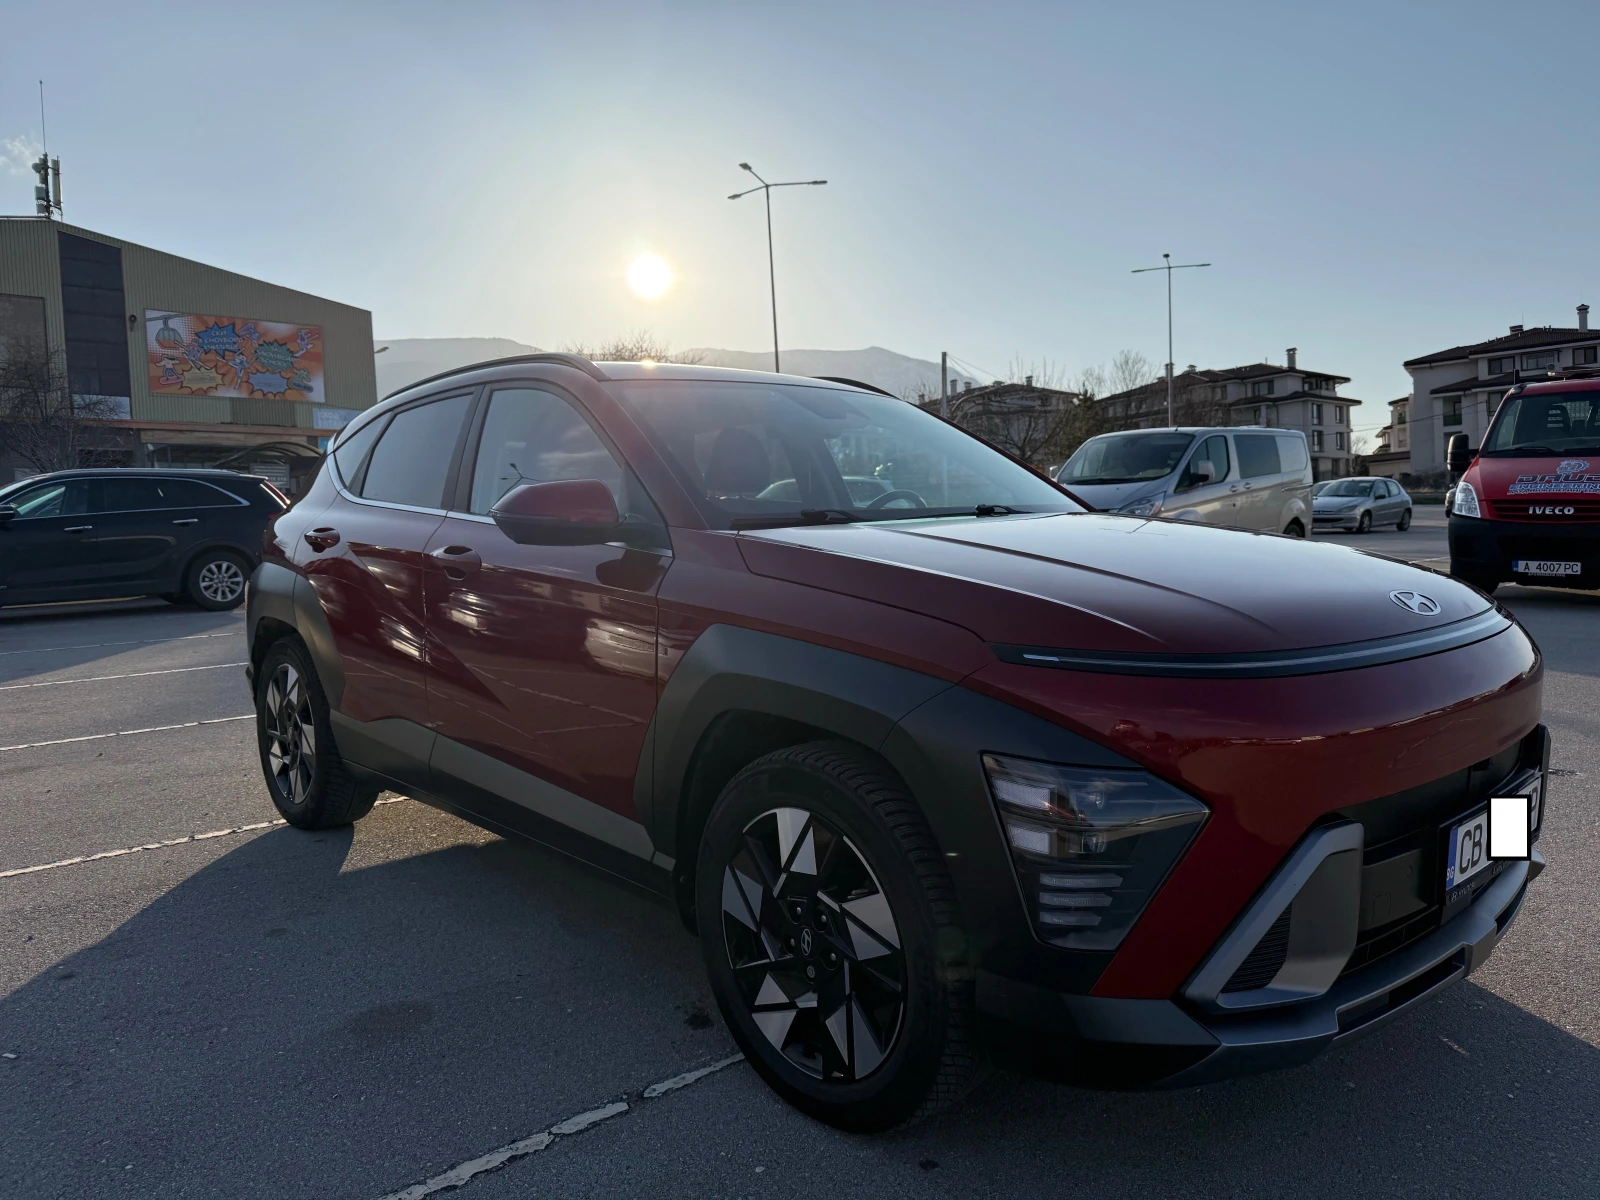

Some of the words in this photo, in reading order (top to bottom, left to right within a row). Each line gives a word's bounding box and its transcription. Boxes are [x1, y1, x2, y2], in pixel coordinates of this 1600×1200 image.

[1528, 506, 1574, 514] IVECO
[1523, 562, 1530, 572] A
[1535, 562, 1562, 573] 4007
[1563, 563, 1579, 573] PC
[1460, 823, 1482, 874] CB
